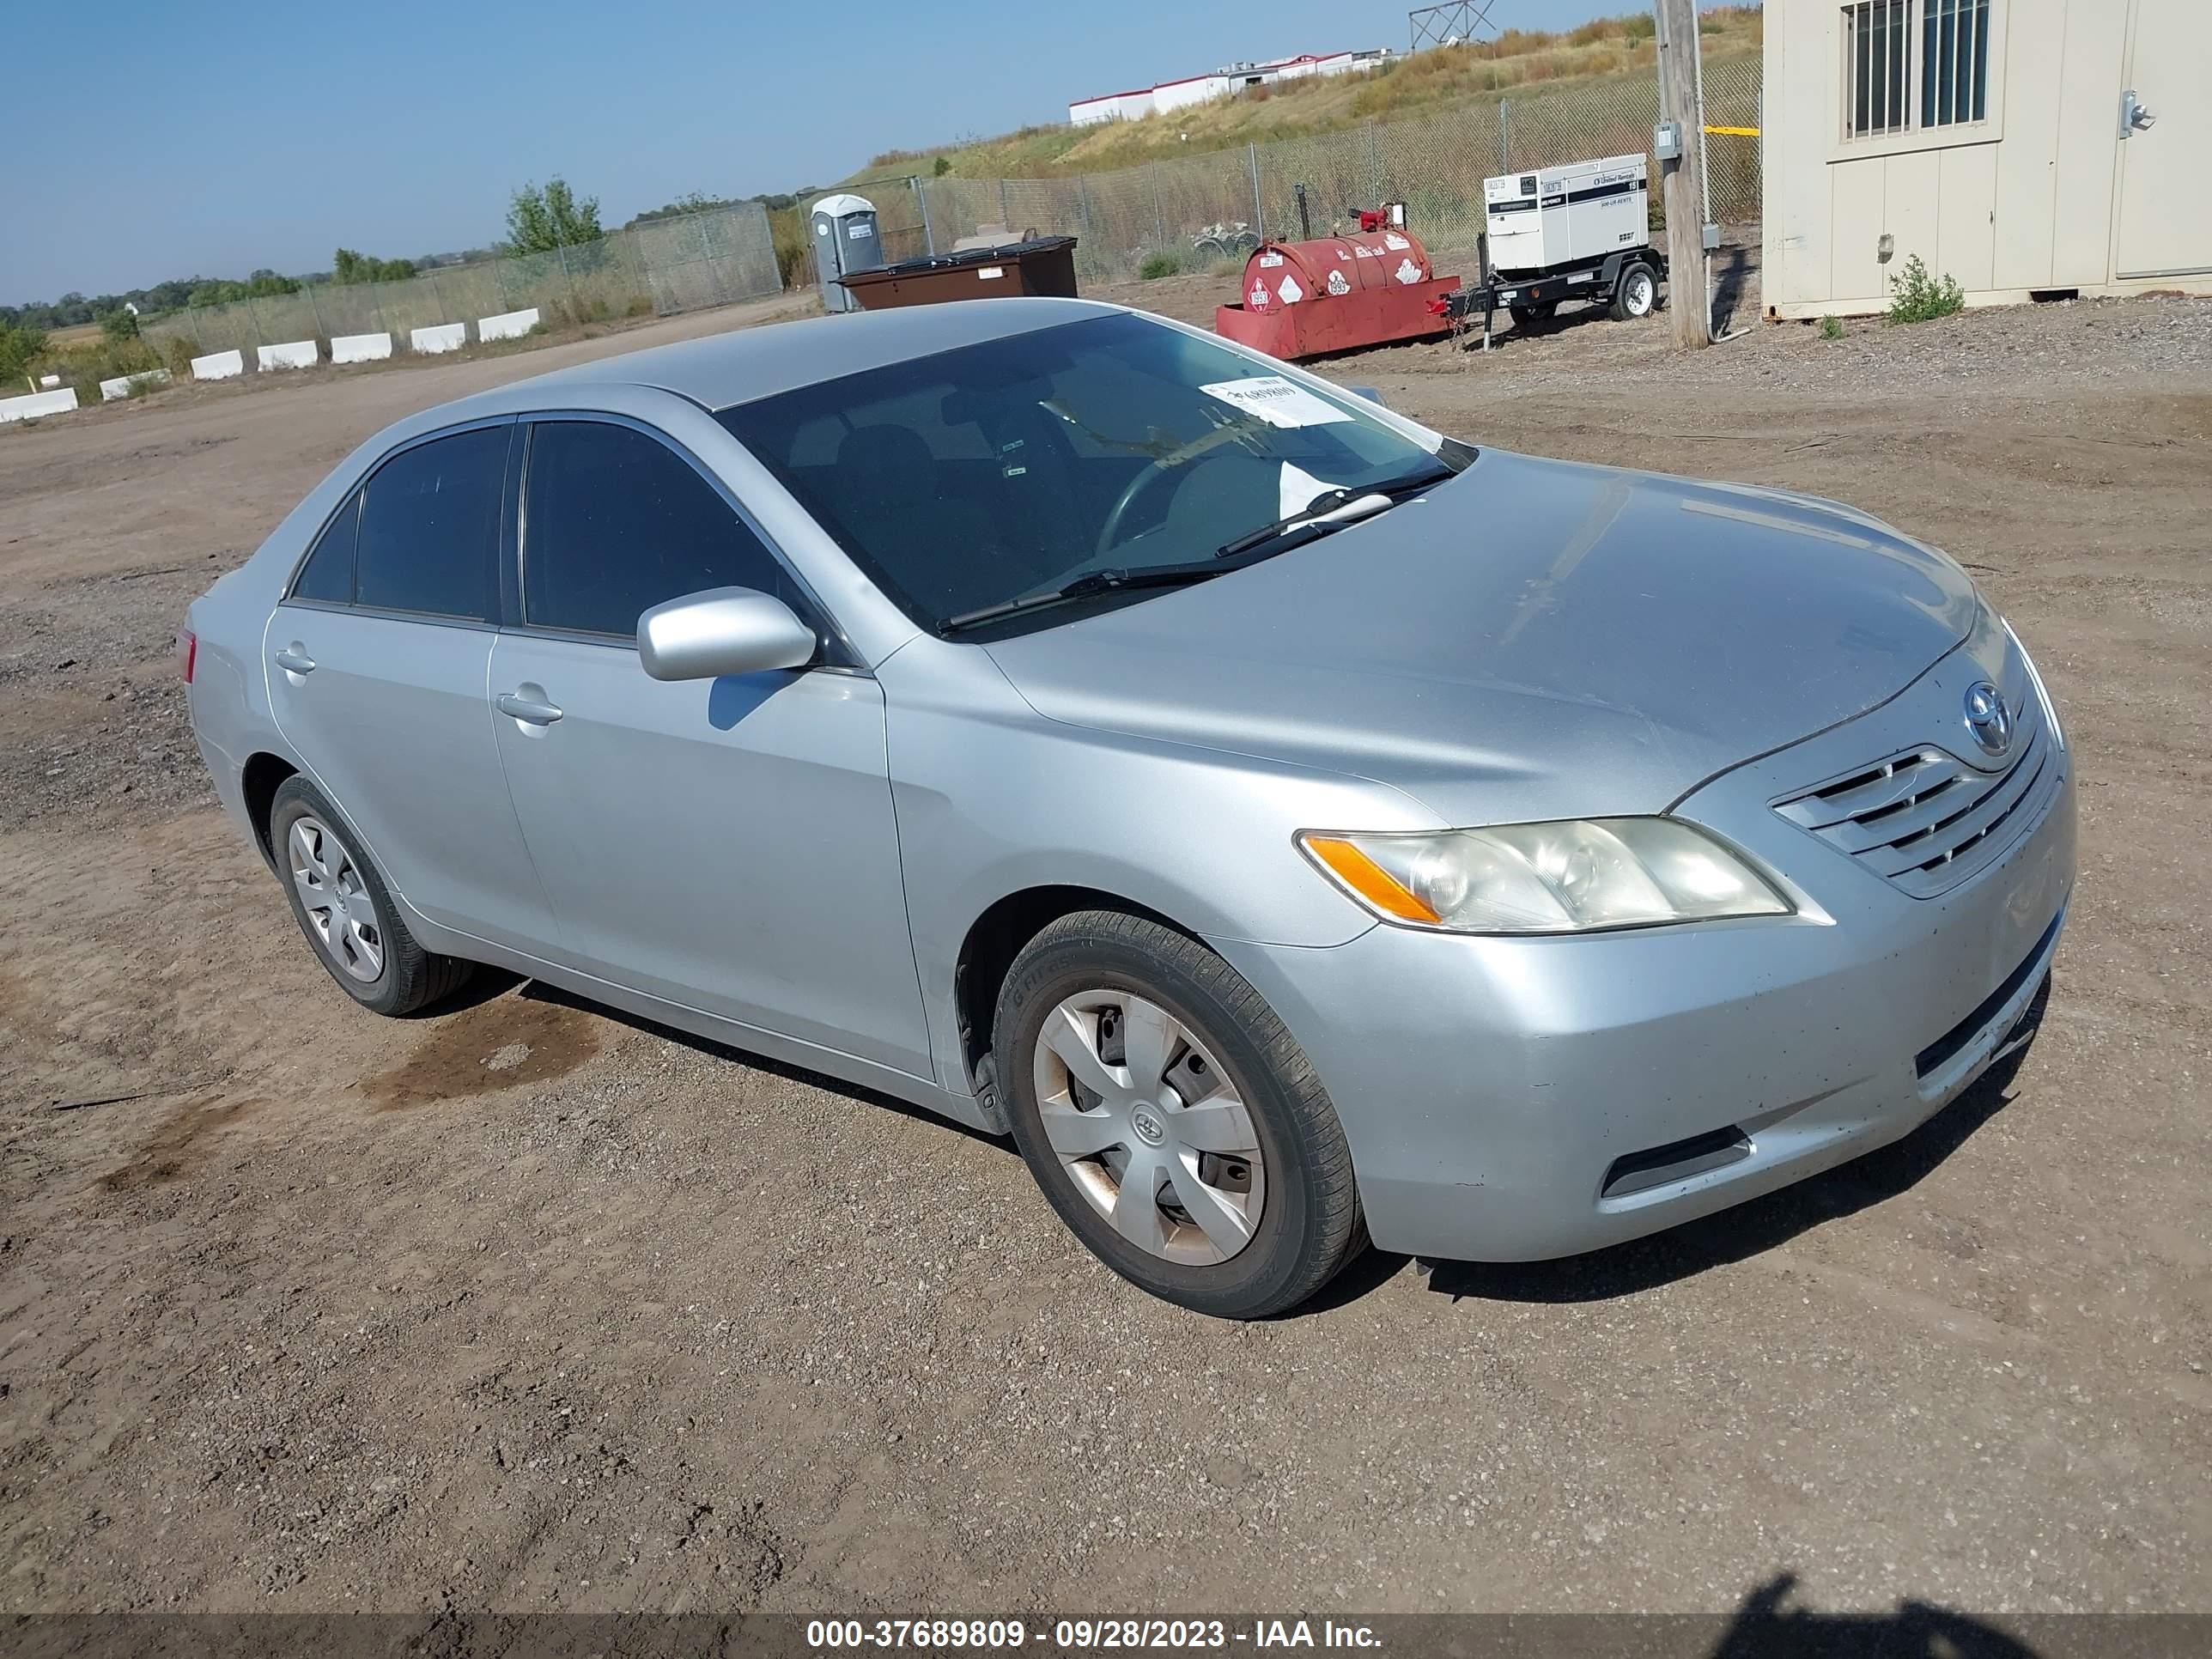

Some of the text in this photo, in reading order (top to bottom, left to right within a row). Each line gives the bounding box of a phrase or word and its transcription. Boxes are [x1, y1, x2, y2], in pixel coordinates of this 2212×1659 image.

[1601, 173, 1636, 185] United Rentals
[1331, 282, 1346, 293] 1993
[1254, 292, 1267, 304] 1993
